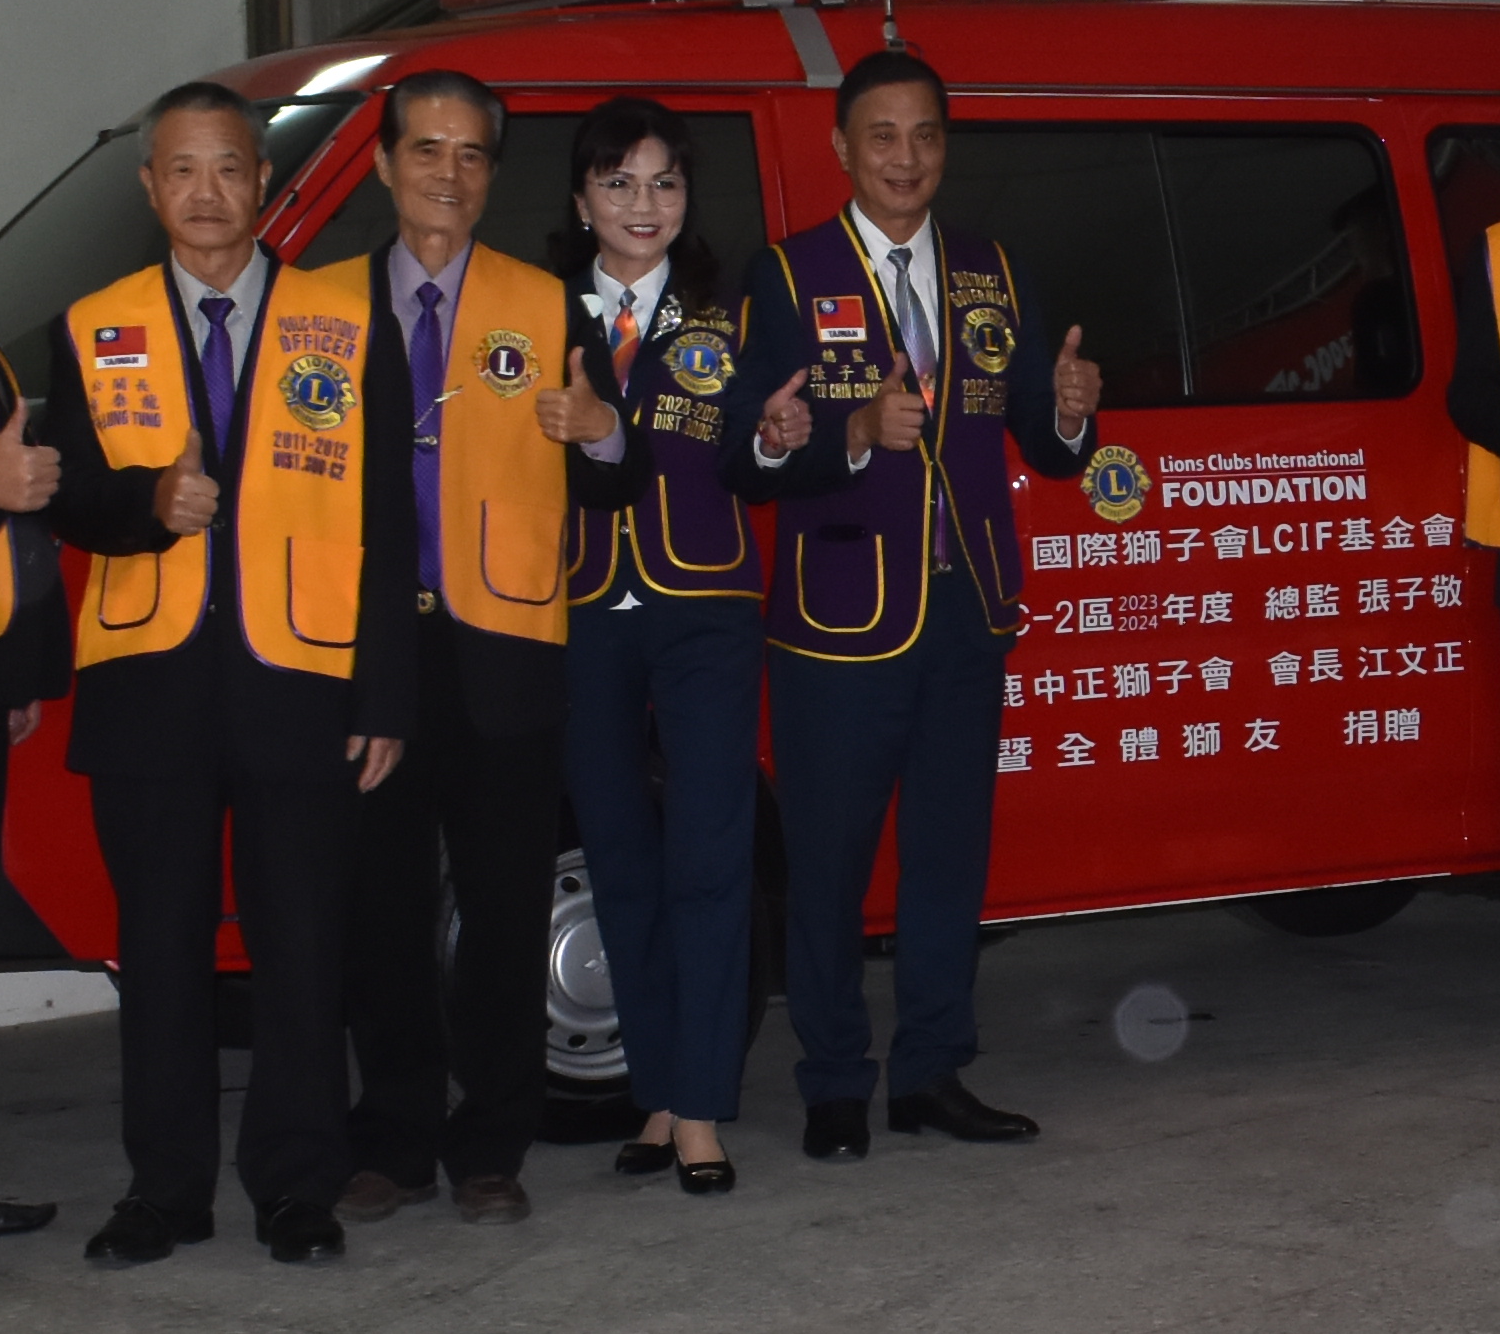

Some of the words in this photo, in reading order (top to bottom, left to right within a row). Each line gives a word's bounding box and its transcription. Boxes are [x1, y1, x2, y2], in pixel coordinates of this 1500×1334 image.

[280, 333, 357, 359] OFFICER
[490, 332, 528, 350] LIONS
[498, 350, 515, 376] L
[692, 351, 711, 374] L
[810, 365, 882, 381] 張子敬
[310, 378, 329, 407] L
[273, 431, 350, 461] 2011-2012
[1092, 448, 1135, 465] LIONS
[1160, 455, 1205, 473] Lions
[1208, 452, 1252, 472] Clubs
[1256, 448, 1365, 470] International
[1107, 469, 1128, 496] L
[1161, 475, 1367, 508] FOUNDATION
[1031, 513, 1456, 571] 國際獅子會LCIF基金會
[1118, 594, 1159, 612] 2023
[1264, 583, 1341, 621] 總監
[1357, 574, 1463, 615] 張子敬
[1162, 591, 1234, 626] 年度
[1118, 614, 1159, 632] 2024
[1266, 648, 1344, 686] 會長
[1357, 641, 1466, 679] 江文正
[1342, 707, 1421, 746] 捐贈
